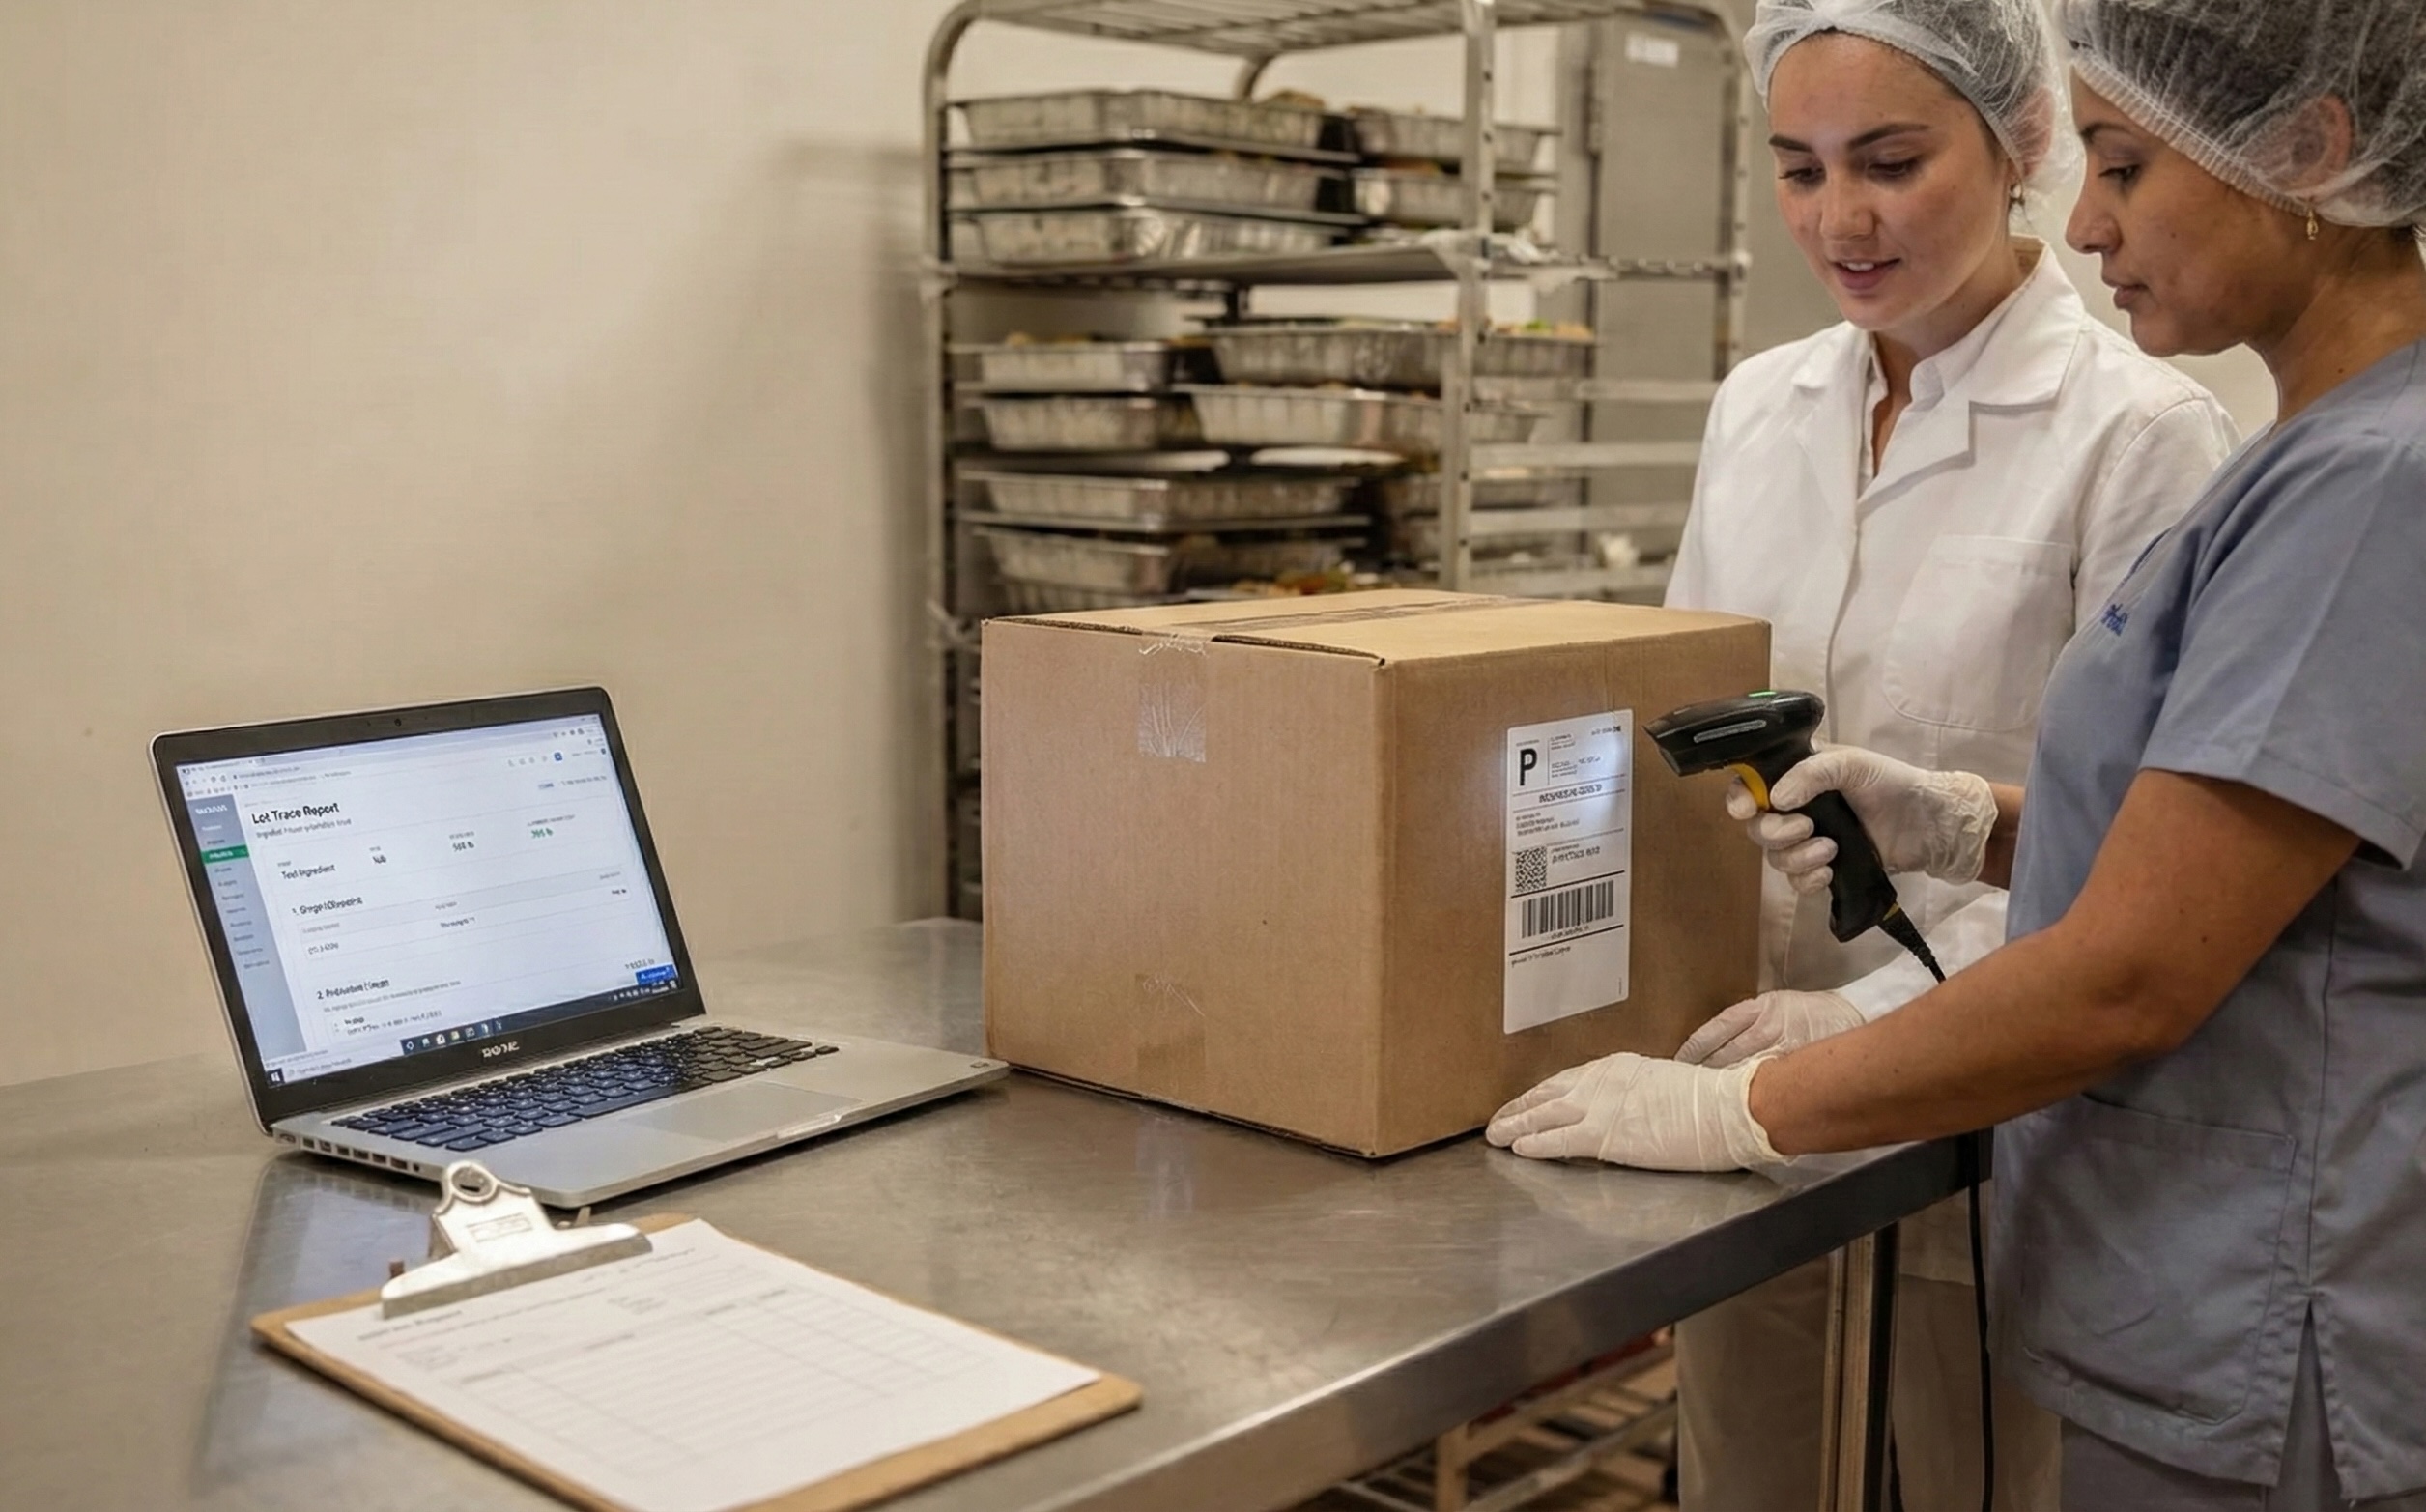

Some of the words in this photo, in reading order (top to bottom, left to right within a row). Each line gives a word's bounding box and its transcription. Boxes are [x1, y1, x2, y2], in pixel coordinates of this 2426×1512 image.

[1520, 748, 1537, 786] P
[271, 810, 301, 821] Trace
[303, 803, 339, 817] Report
